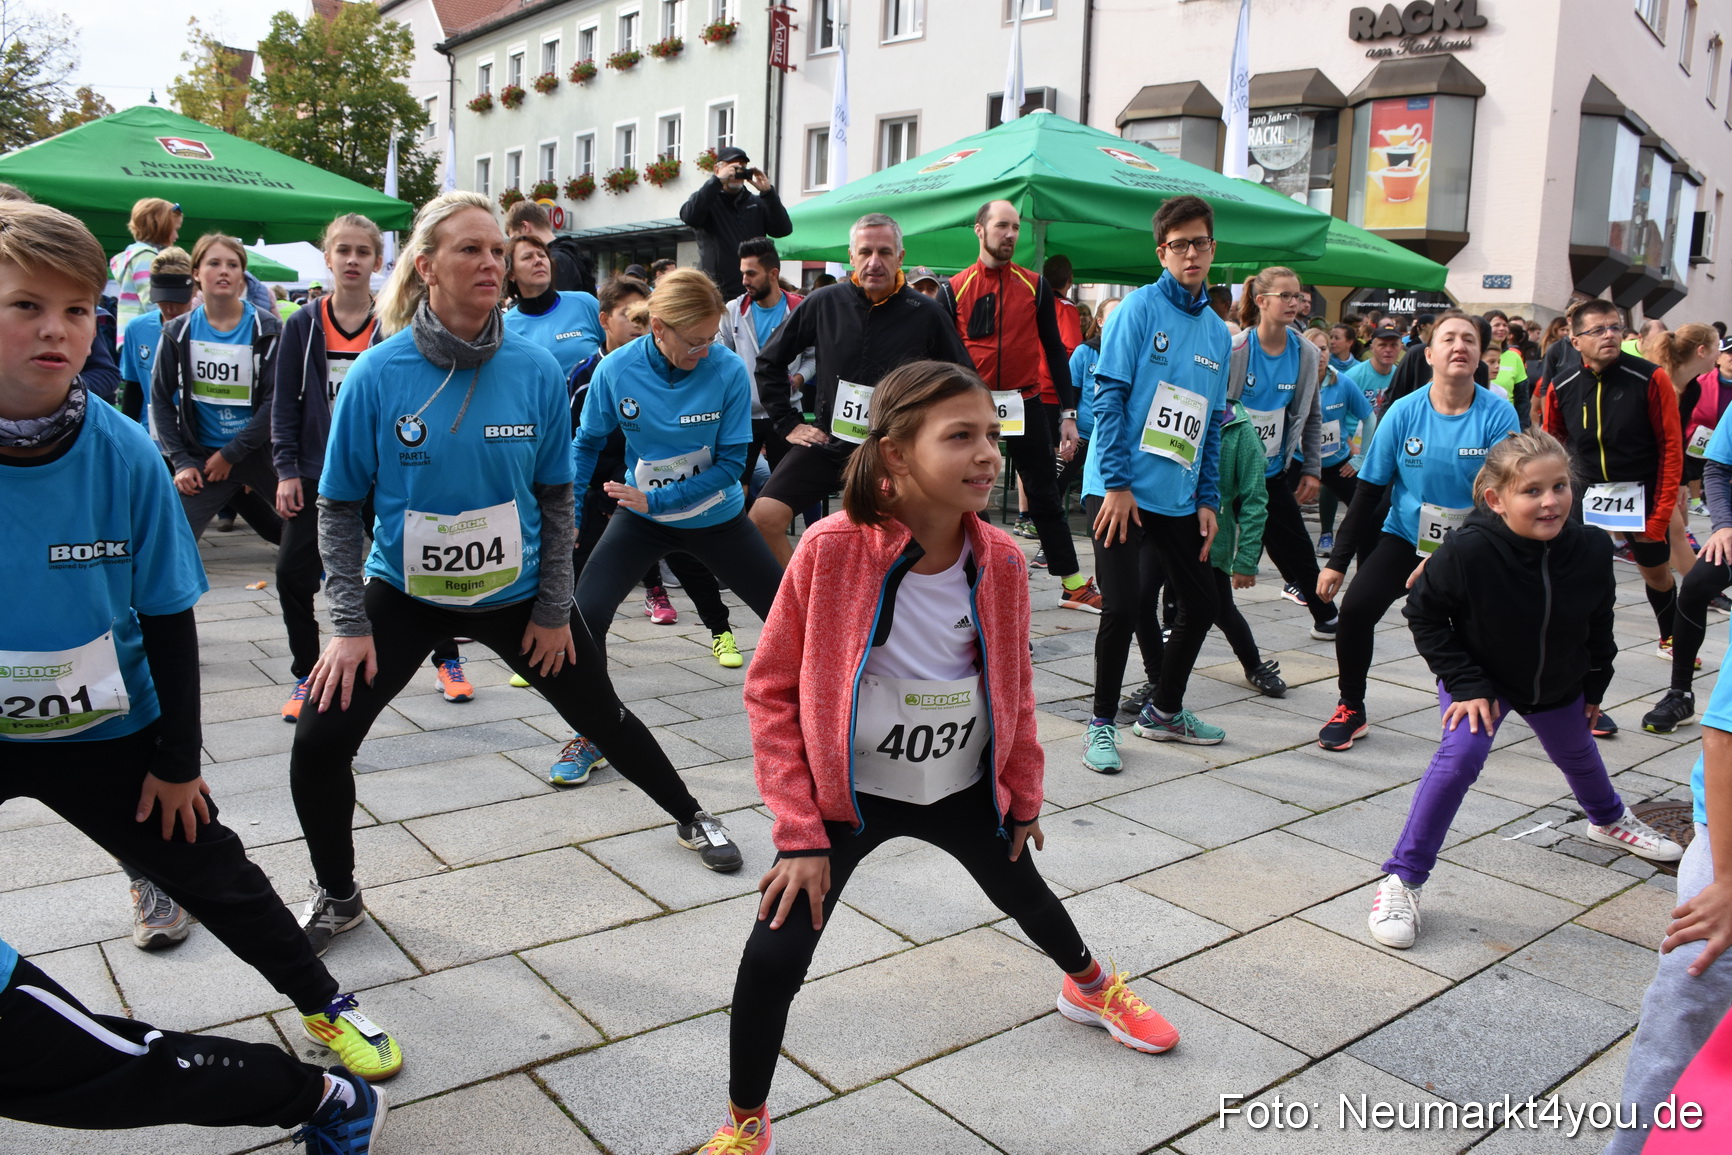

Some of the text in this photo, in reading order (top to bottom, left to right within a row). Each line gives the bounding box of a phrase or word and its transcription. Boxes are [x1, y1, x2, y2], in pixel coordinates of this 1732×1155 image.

[1348, 0, 1488, 42] RACKL
[775, 18, 787, 63] Achatz
[1365, 36, 1473, 58] am Rathaus
[1252, 112, 1292, 126] 100 Jahre
[1248, 125, 1285, 146] RACKL
[139, 160, 263, 178] Neumarkter
[1388, 298, 1416, 312] RACKL
[555, 330, 583, 340] BOCK
[1194, 354, 1220, 371] BOCK
[197, 360, 239, 382] 5091
[206, 386, 230, 394] Luciana
[217, 408, 236, 420] 18.
[680, 411, 721, 424] BOCK
[485, 424, 536, 438] BOCK
[1157, 406, 1201, 440] 5109
[399, 451, 430, 460] PARTL
[1459, 448, 1488, 456] BOC
[1592, 496, 1635, 512] 2714
[449, 517, 487, 532] BOCK
[50, 541, 128, 562] BOCK
[422, 536, 505, 572] 5204
[445, 580, 485, 592] Regine
[13, 661, 74, 678] BOCK
[921, 690, 971, 706] BOCK
[12, 716, 70, 729] Pascal
[876, 716, 977, 763] 4031
